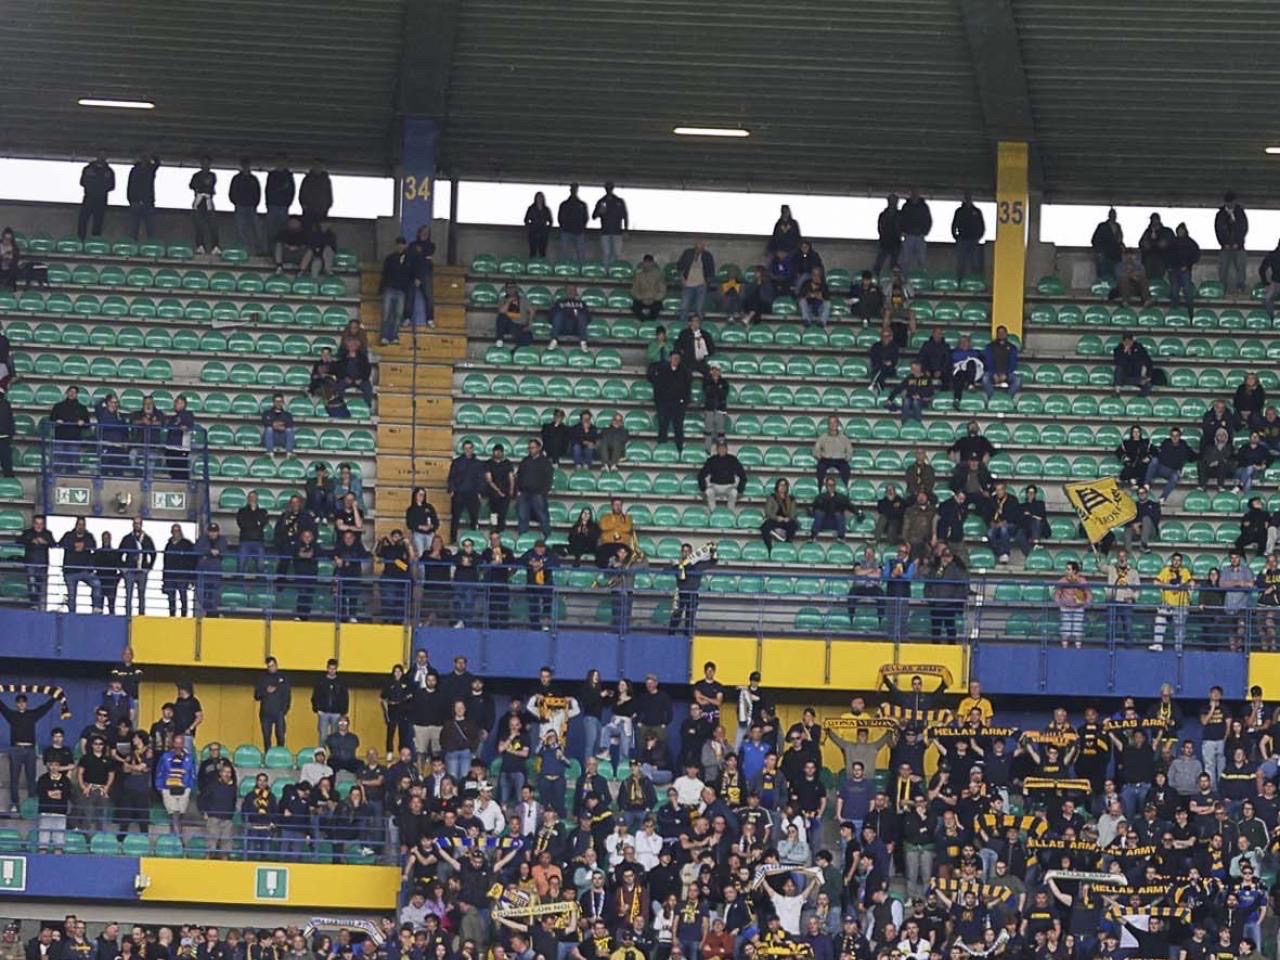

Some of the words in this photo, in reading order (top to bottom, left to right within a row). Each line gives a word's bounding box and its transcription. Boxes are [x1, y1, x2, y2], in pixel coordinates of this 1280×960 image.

[404, 176, 432, 202] 34
[999, 200, 1024, 226] 35
[934, 727, 977, 737] HELLAS
[981, 727, 1015, 736] ARMY
[1092, 884, 1134, 894] HELLAS
[1139, 884, 1170, 894] ARMY
